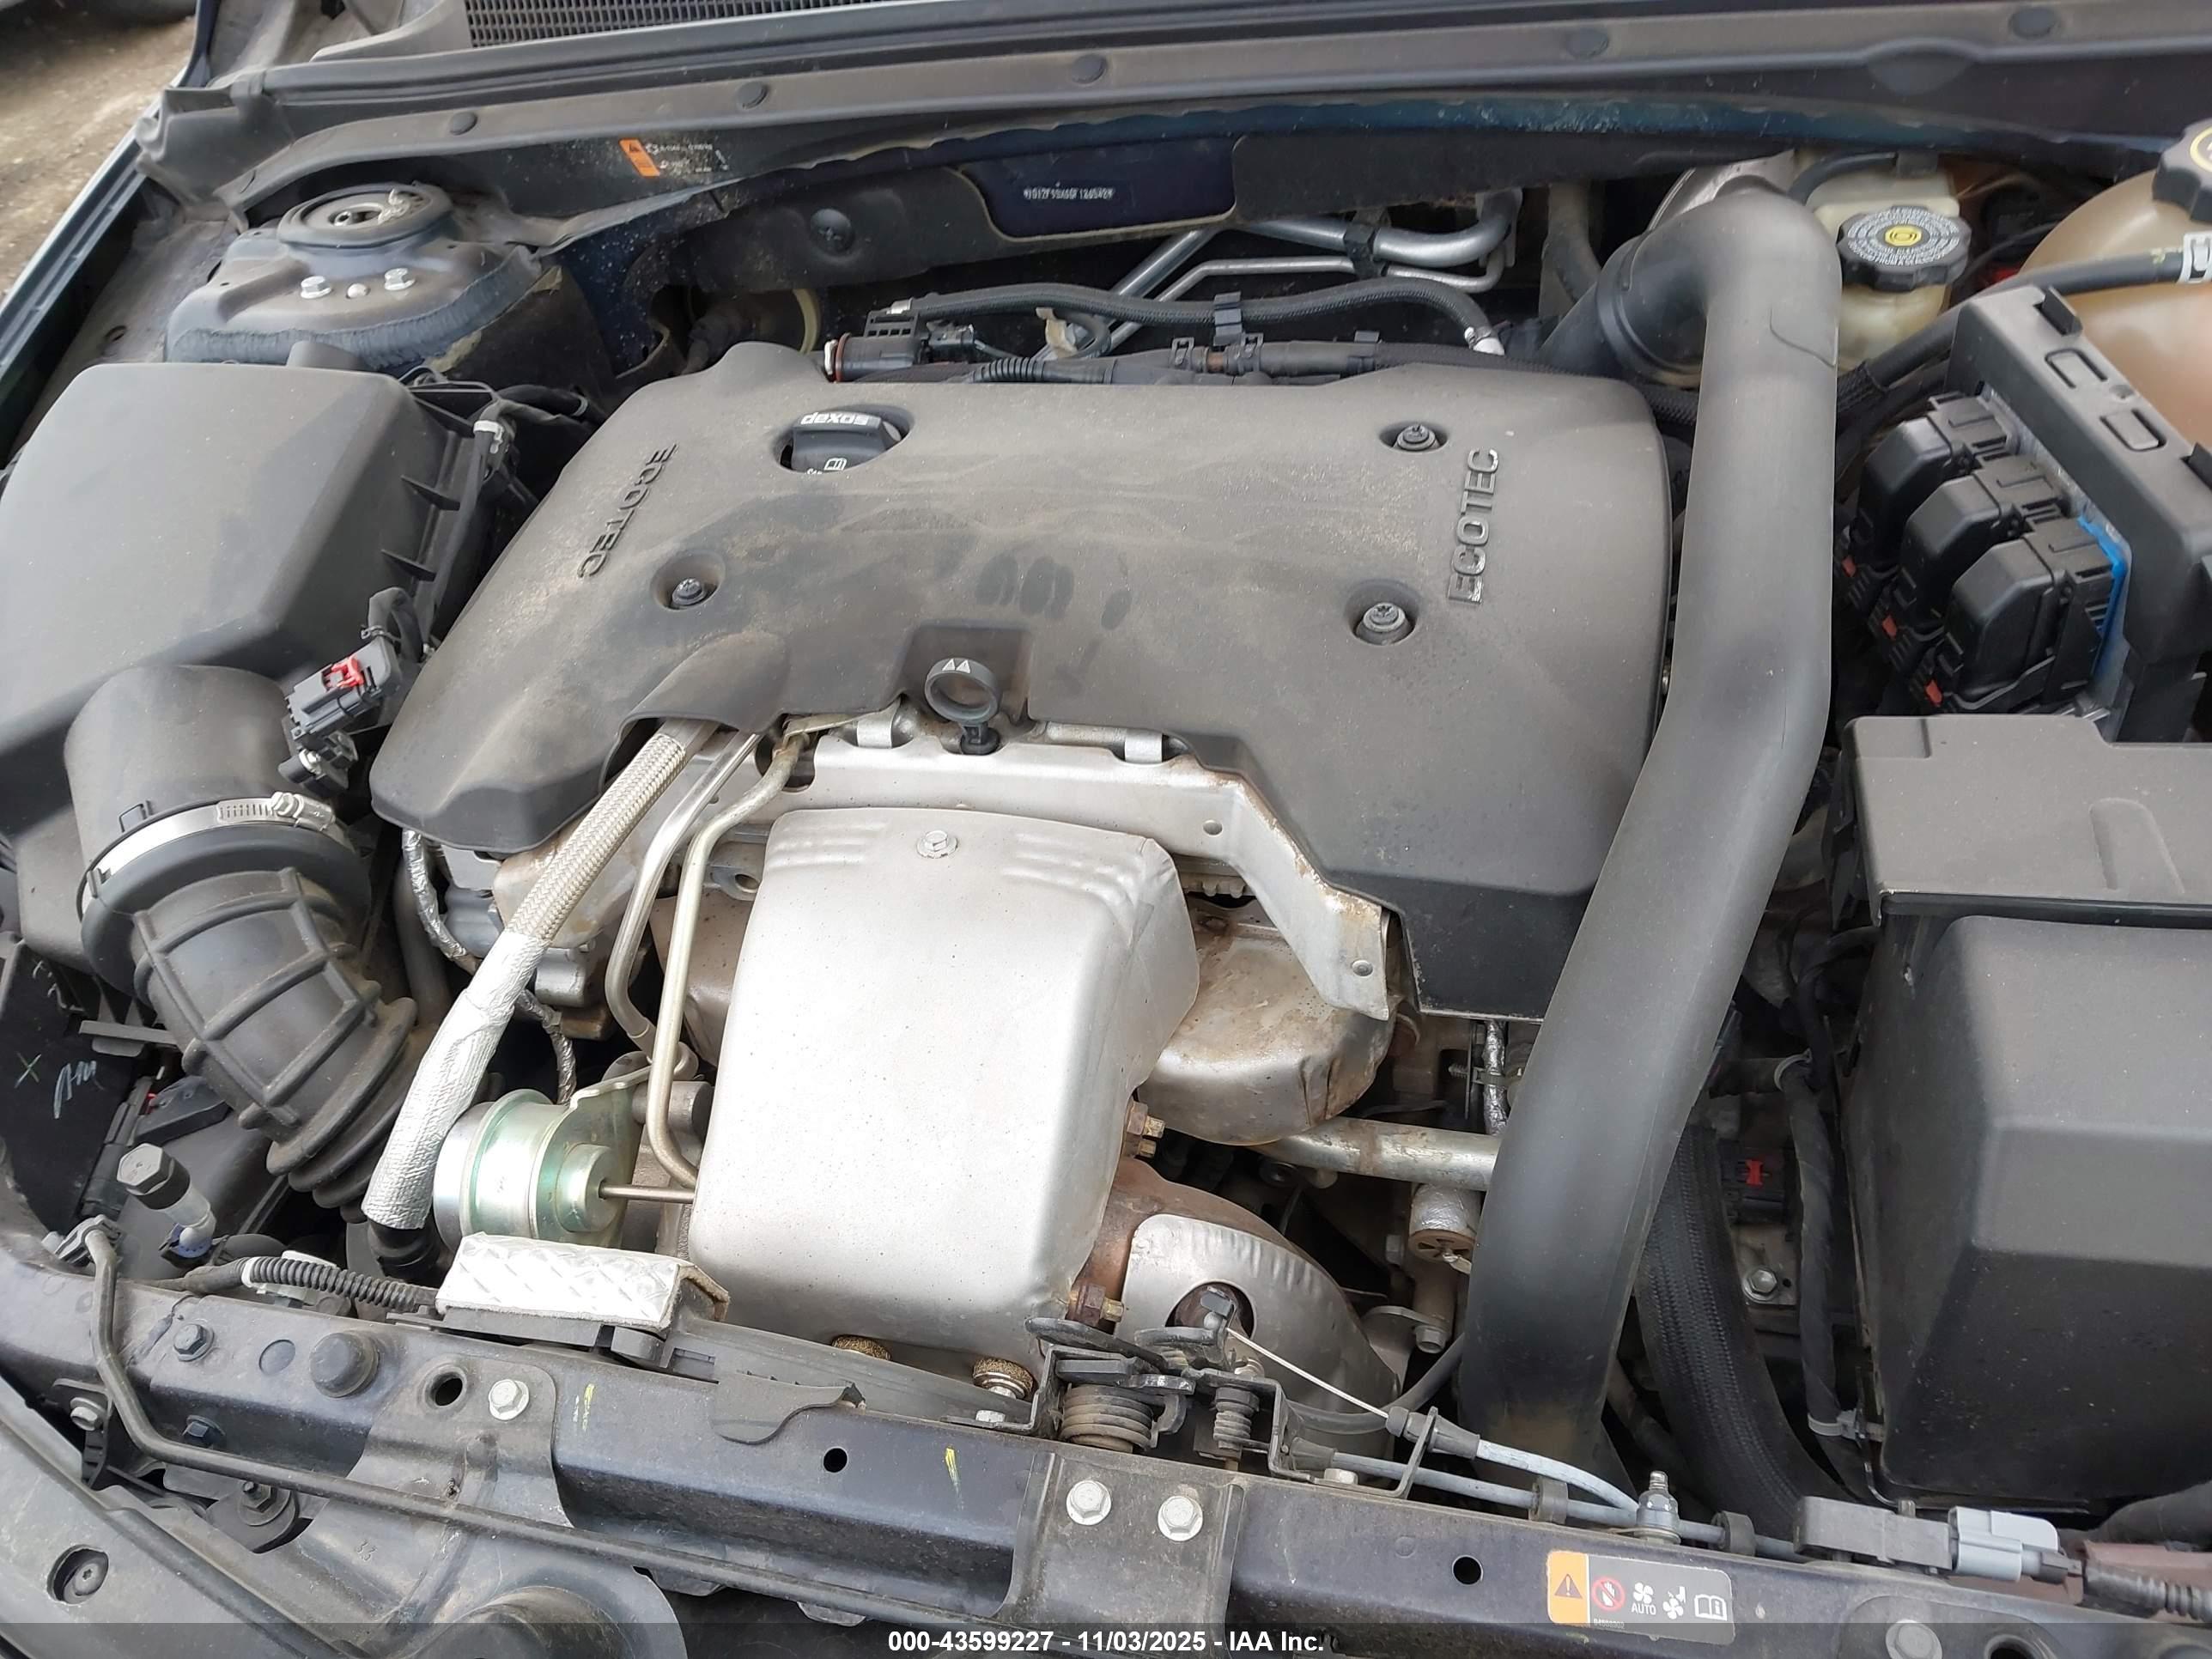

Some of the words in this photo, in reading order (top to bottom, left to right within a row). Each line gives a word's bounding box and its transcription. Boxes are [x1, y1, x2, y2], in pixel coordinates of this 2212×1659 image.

[800, 411, 870, 427] dexos
[576, 443, 678, 579] ECOTEC
[1448, 448, 1499, 606] ECOTEC
[1631, 1601, 1656, 1616] AUTO
